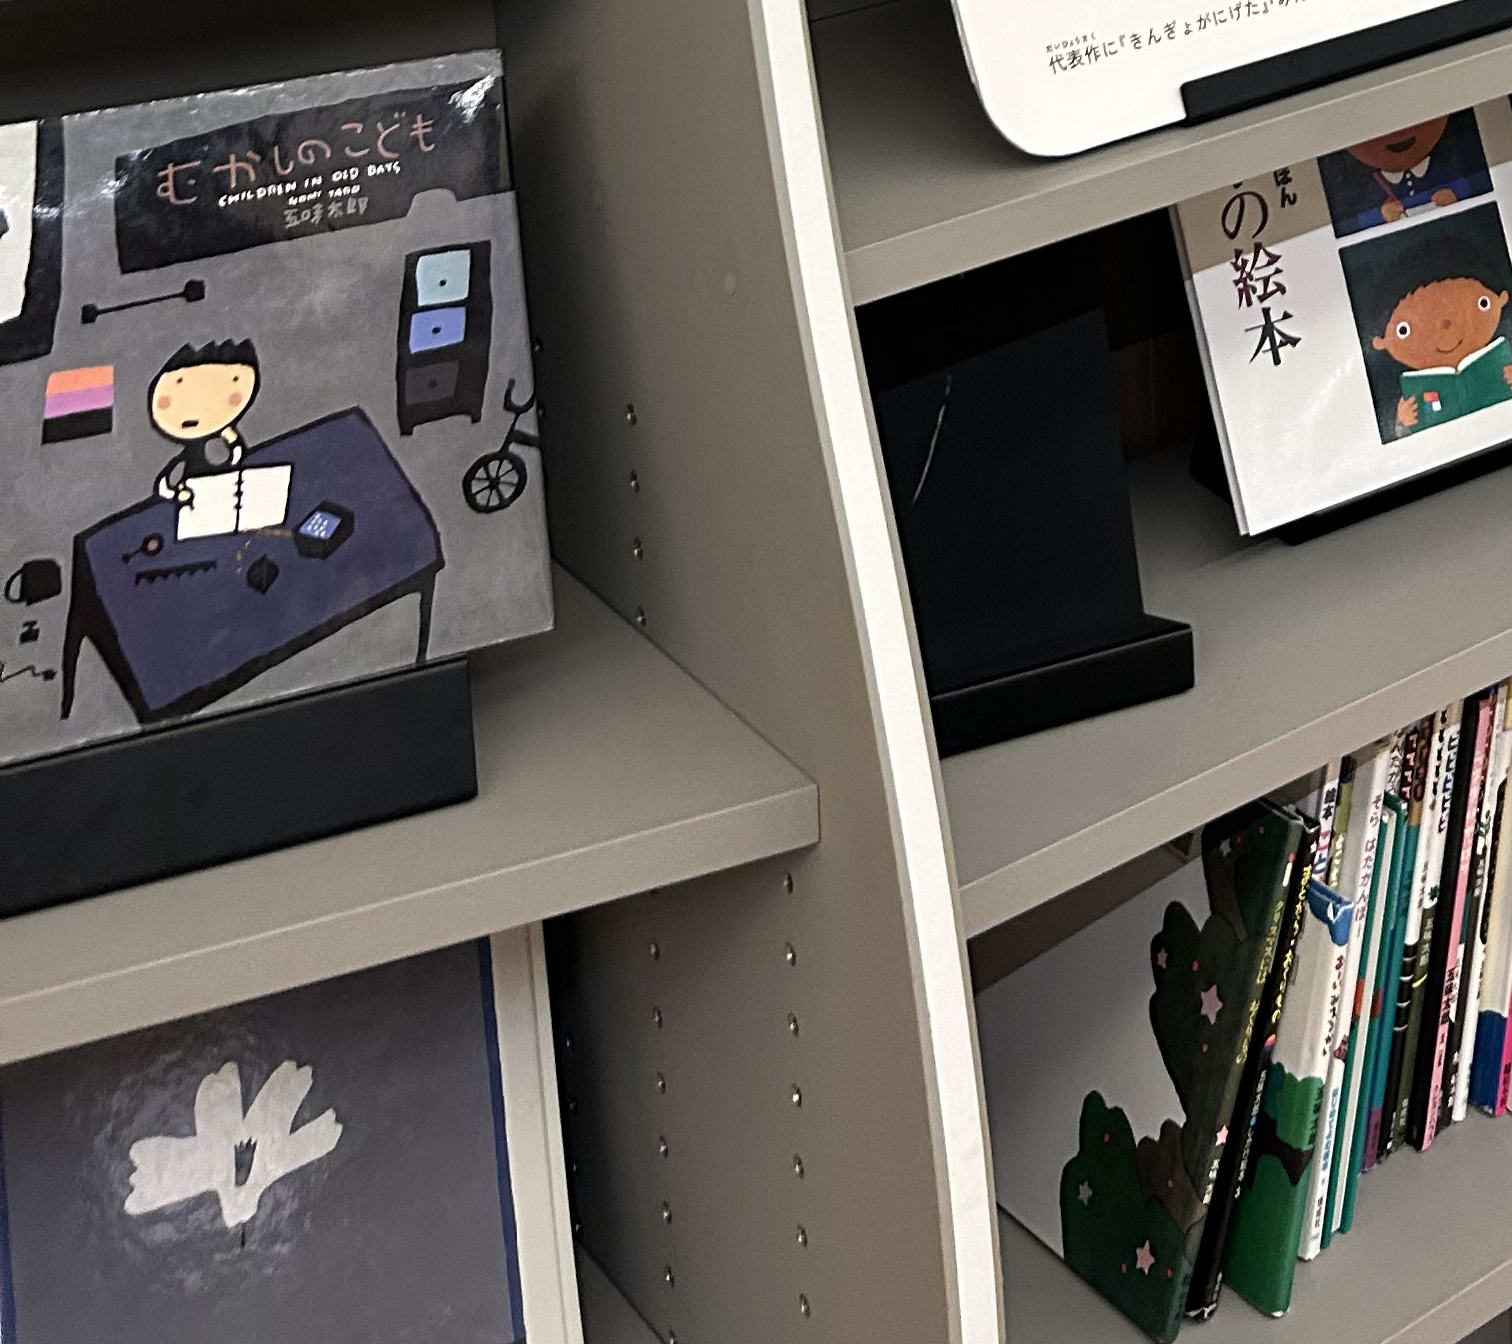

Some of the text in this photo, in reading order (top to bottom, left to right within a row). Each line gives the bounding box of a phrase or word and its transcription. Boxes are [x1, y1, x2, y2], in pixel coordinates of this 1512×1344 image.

[156, 111, 436, 206] むかしのこども
[217, 179, 298, 208] CHILDREN
[304, 175, 323, 188] IN
[332, 166, 360, 182] OLD
[283, 196, 370, 230] 五味太郎
